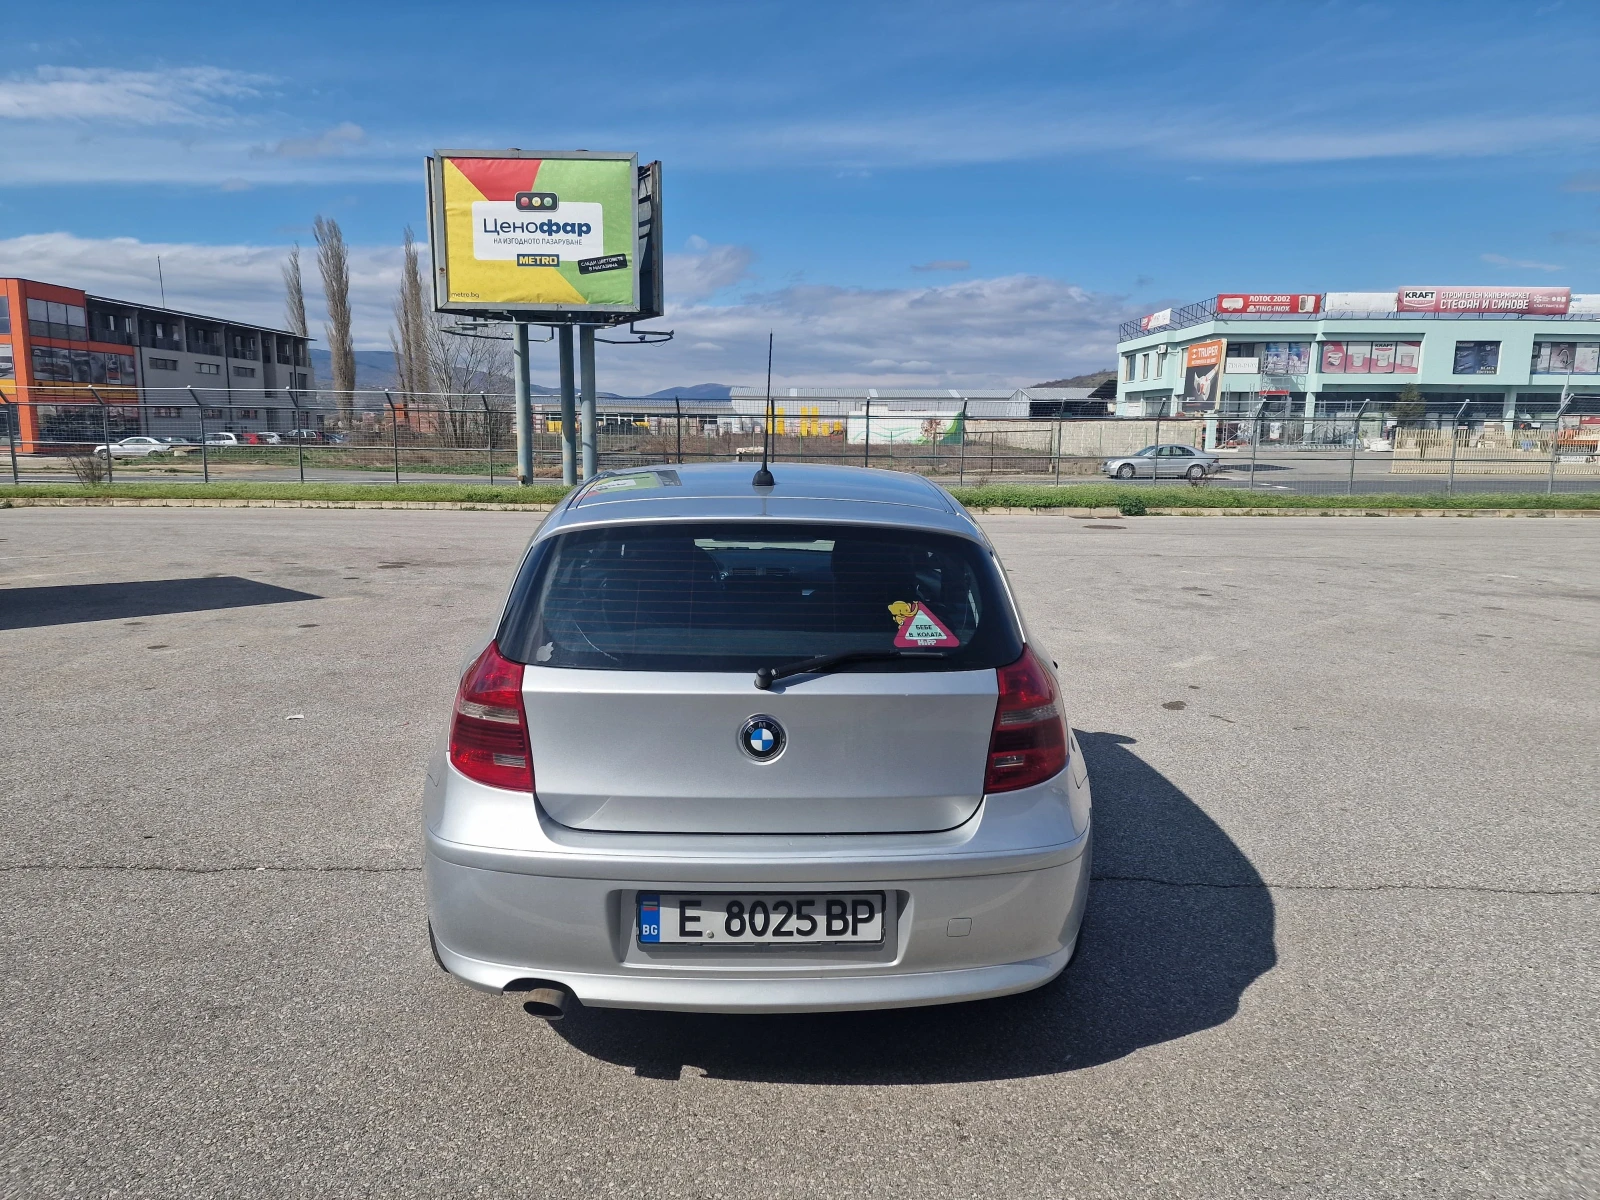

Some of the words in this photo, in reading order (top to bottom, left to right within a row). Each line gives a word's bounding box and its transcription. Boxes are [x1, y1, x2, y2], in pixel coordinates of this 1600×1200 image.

[483, 218, 592, 237] Ценофар
[519, 255, 558, 265] METRO
[1248, 295, 1271, 303] ЛОТОС
[1405, 291, 1435, 299] KRAFT
[1441, 291, 1484, 299] СТРОИТЕЛЕН
[1484, 291, 1531, 299] ХИПЕРМАРКЕТ
[1440, 299, 1480, 309] СТЕФАН
[1482, 300, 1490, 309] И
[1491, 299, 1530, 309] СИНОВЕ
[1198, 345, 1219, 358] TRUPER
[747, 721, 779, 734] BMW
[678, 900, 703, 937] E
[724, 899, 818, 937] 8025
[825, 899, 876, 937] BP
[642, 924, 658, 935] BG
